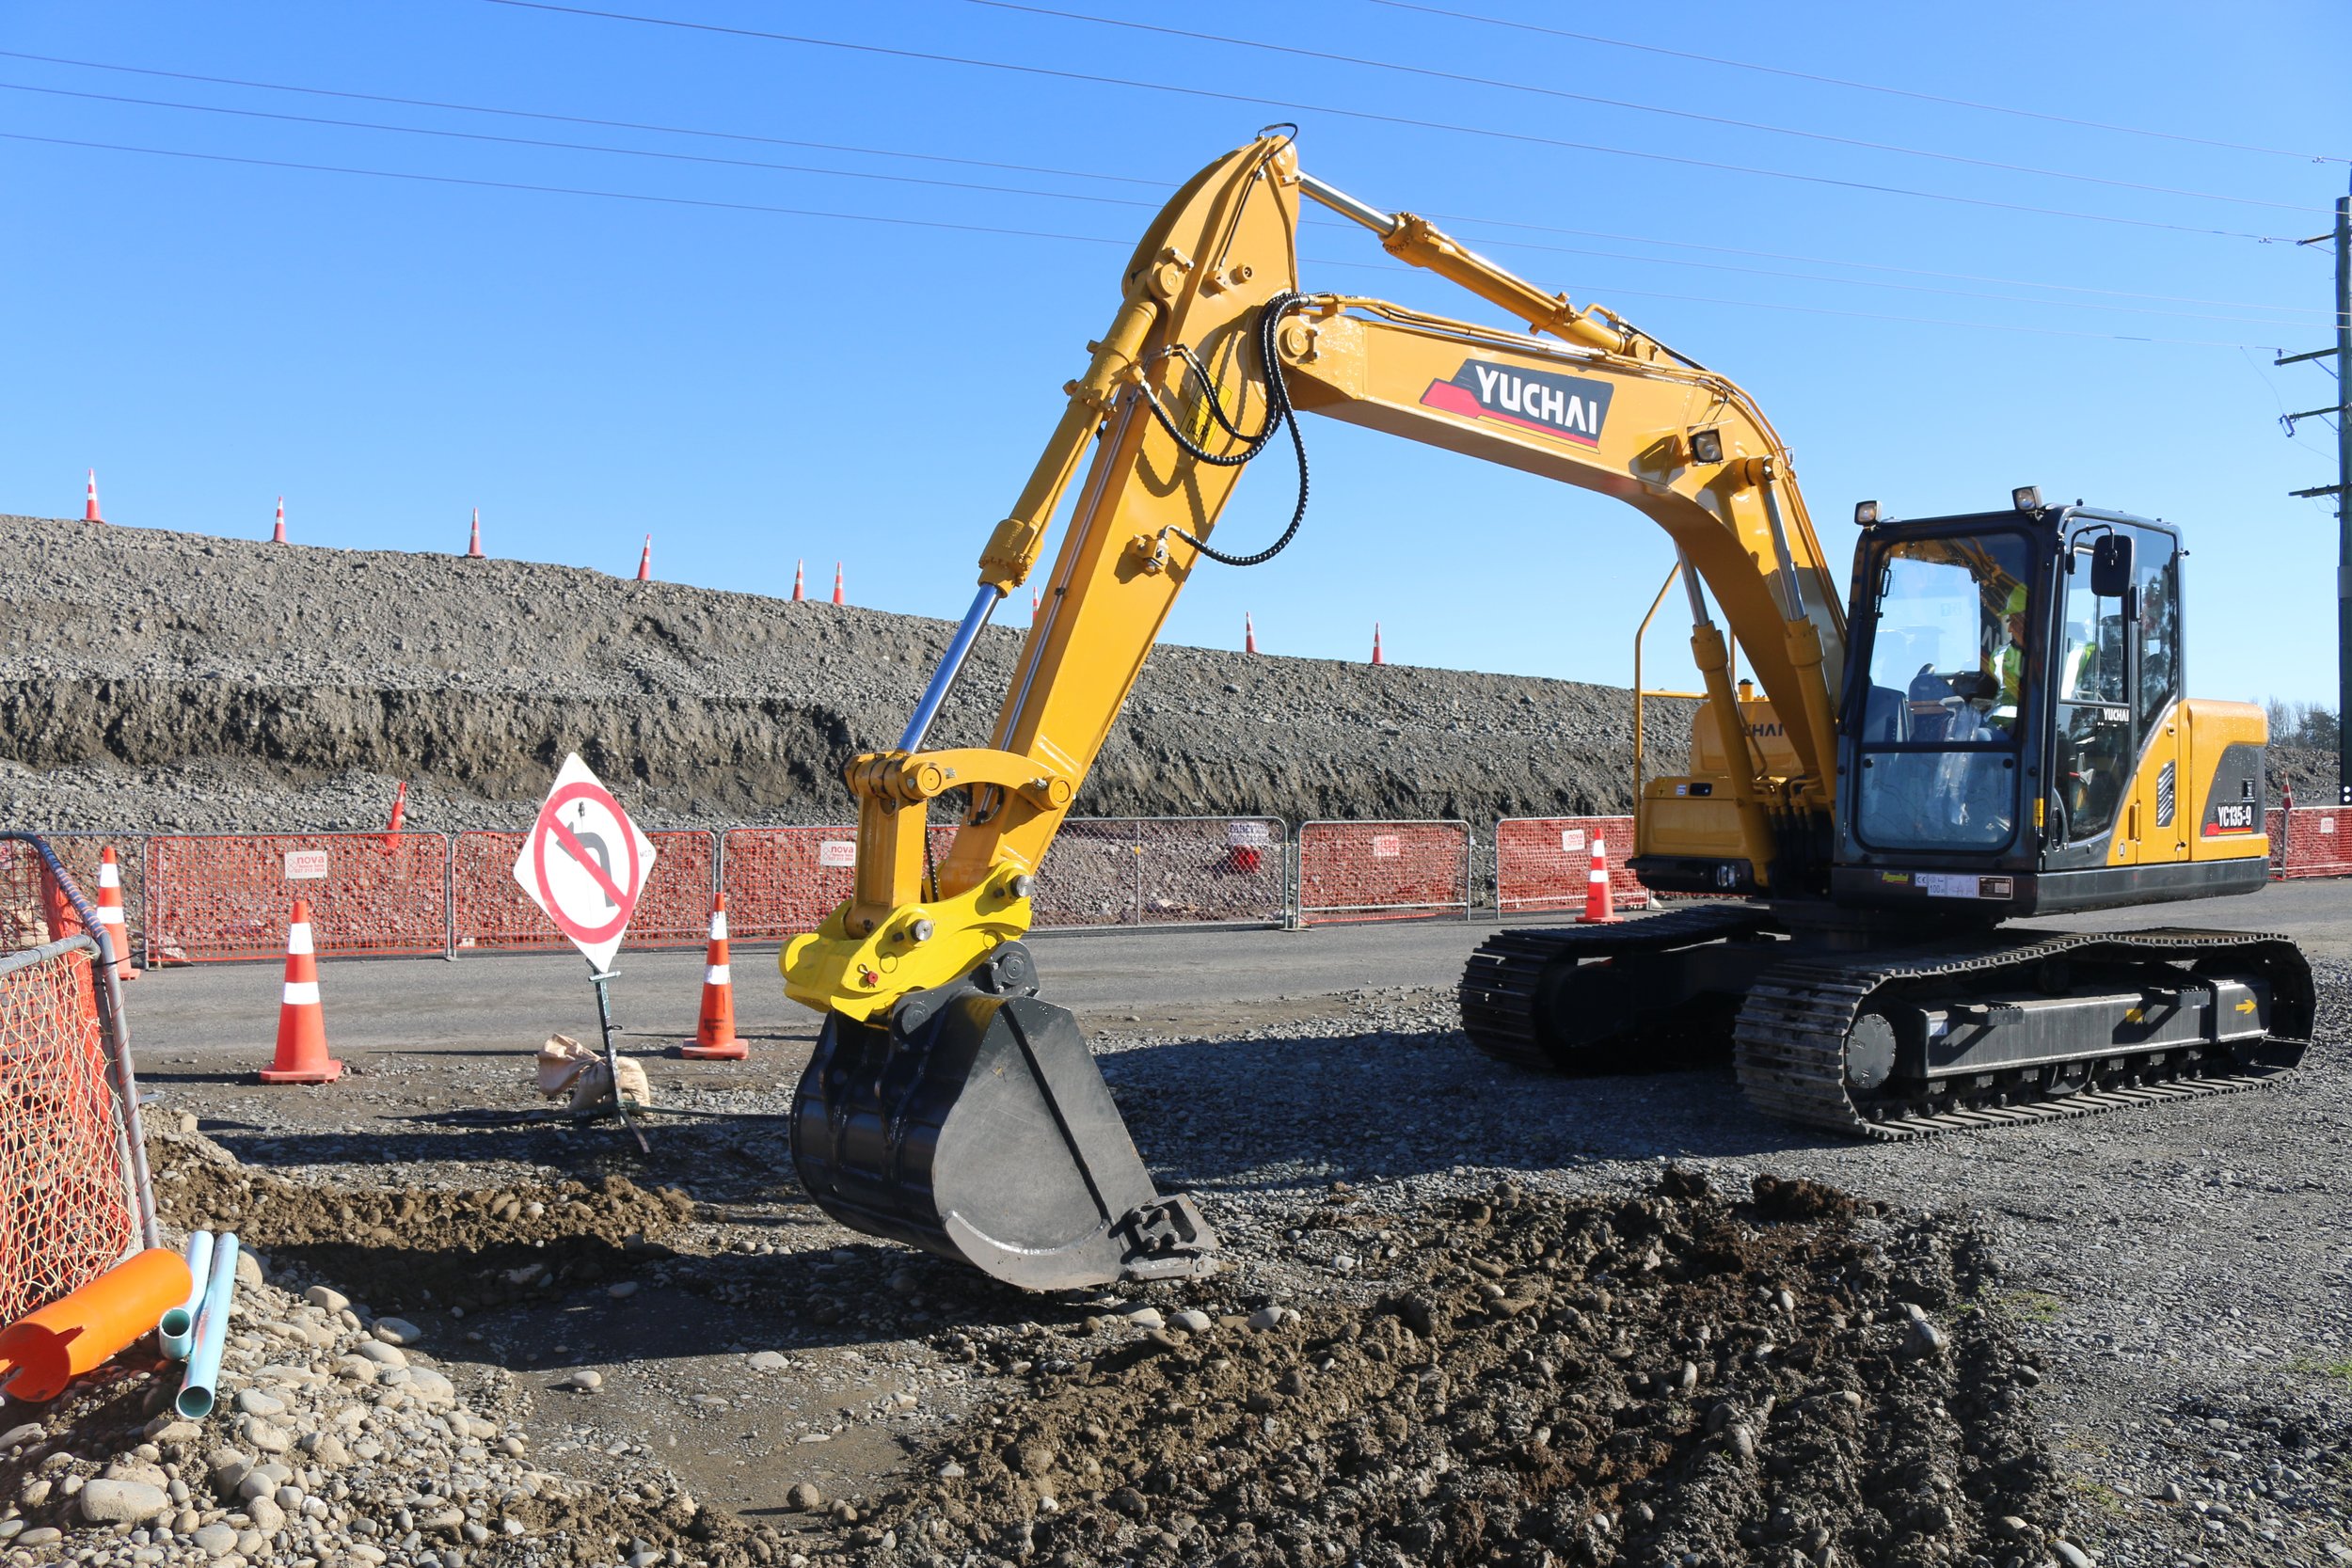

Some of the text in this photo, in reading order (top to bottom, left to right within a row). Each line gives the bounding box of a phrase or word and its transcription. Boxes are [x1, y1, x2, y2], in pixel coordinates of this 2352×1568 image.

[1475, 365, 1597, 435] YUCHAI
[2103, 707, 2130, 722] YUCHAI
[296, 855, 325, 864] nova
